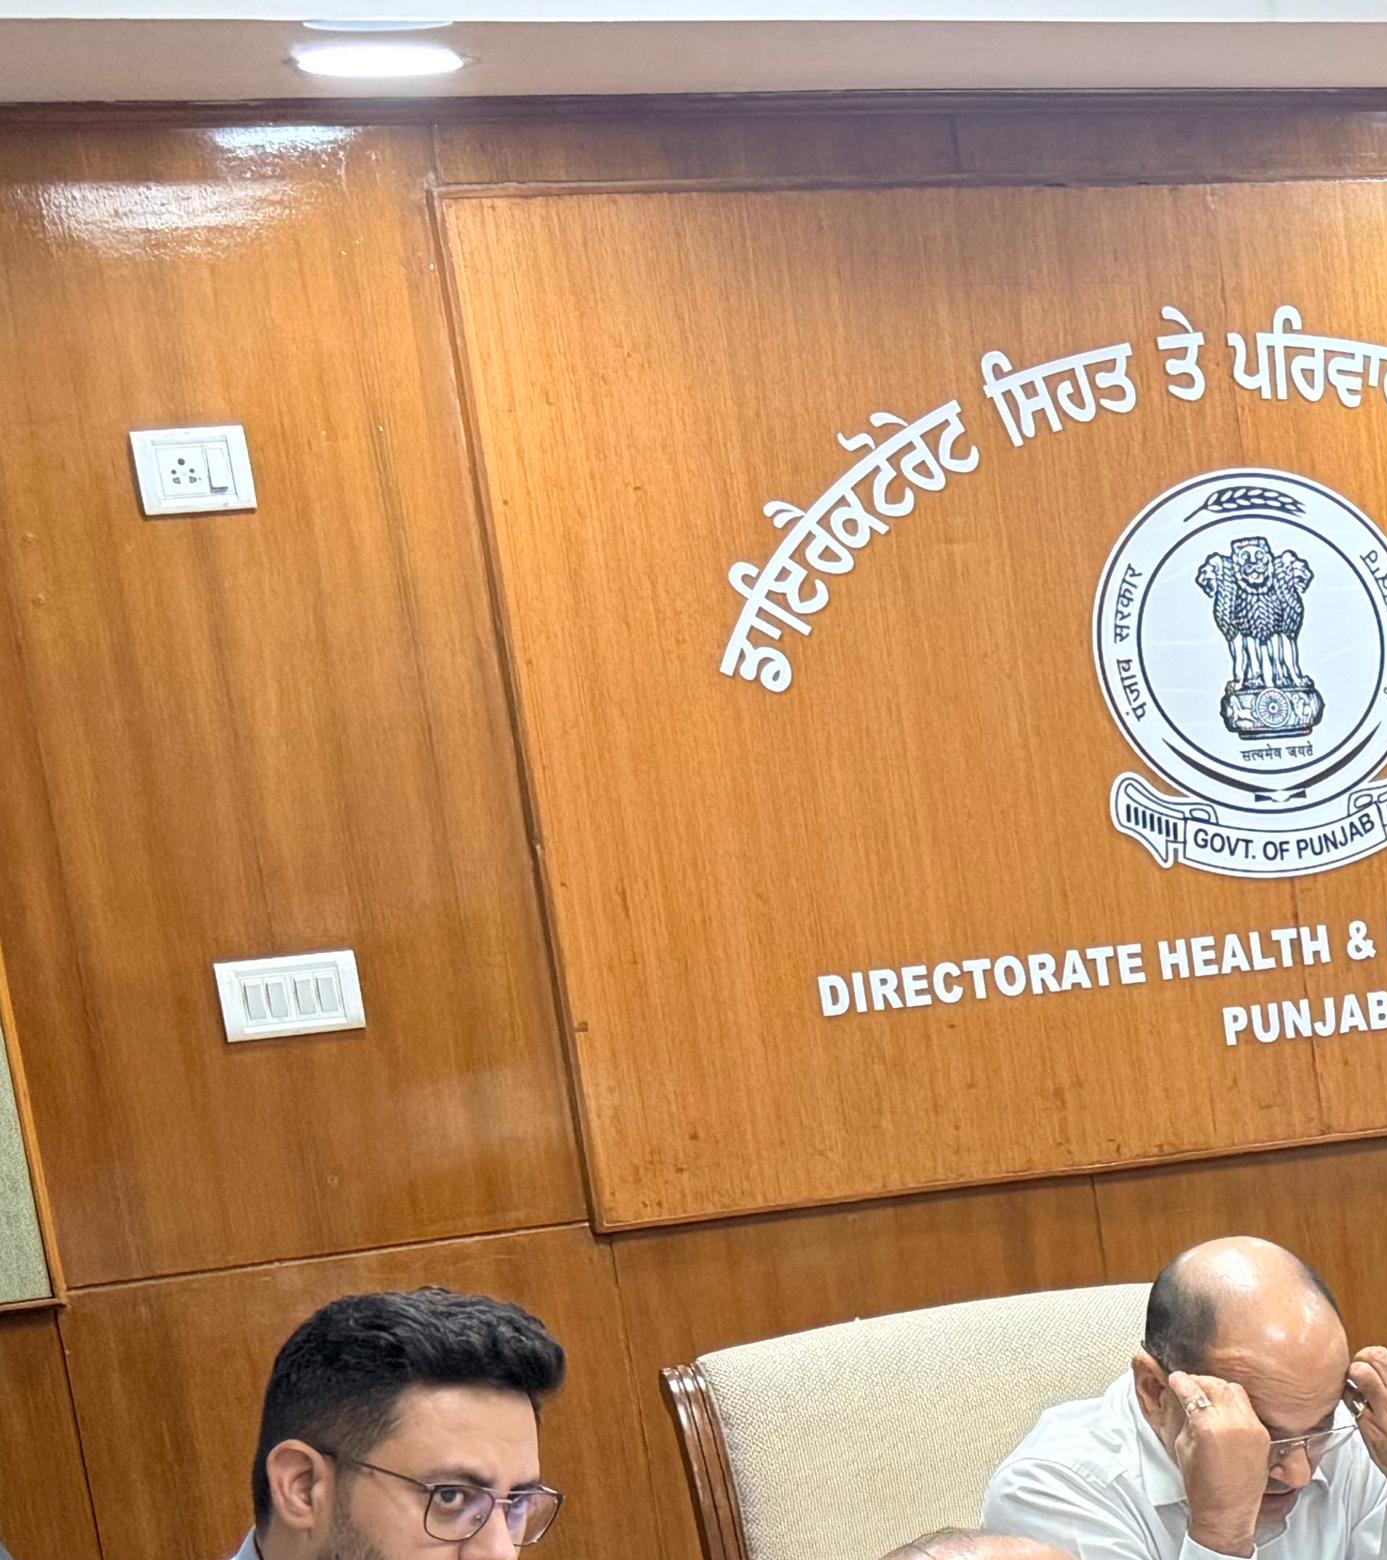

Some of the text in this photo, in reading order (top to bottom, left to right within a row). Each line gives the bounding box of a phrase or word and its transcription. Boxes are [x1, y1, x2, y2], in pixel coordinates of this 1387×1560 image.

[719, 399, 980, 693] ਡਾਇਰੈਕਟੋਰੇਟ
[981, 342, 1136, 447] ਸਿਹਤ
[1156, 305, 1205, 401] ਤੇ
[1114, 563, 1146, 721] पंजाब सरकार
[1240, 740, 1314, 762] सत्यमेव जयते
[1193, 812, 1376, 861] GOVT. OF PUNJAB
[817, 943, 1146, 1017] DIRECTORATE
[1158, 925, 1331, 980] HEALTH
[1346, 920, 1378, 960] &
